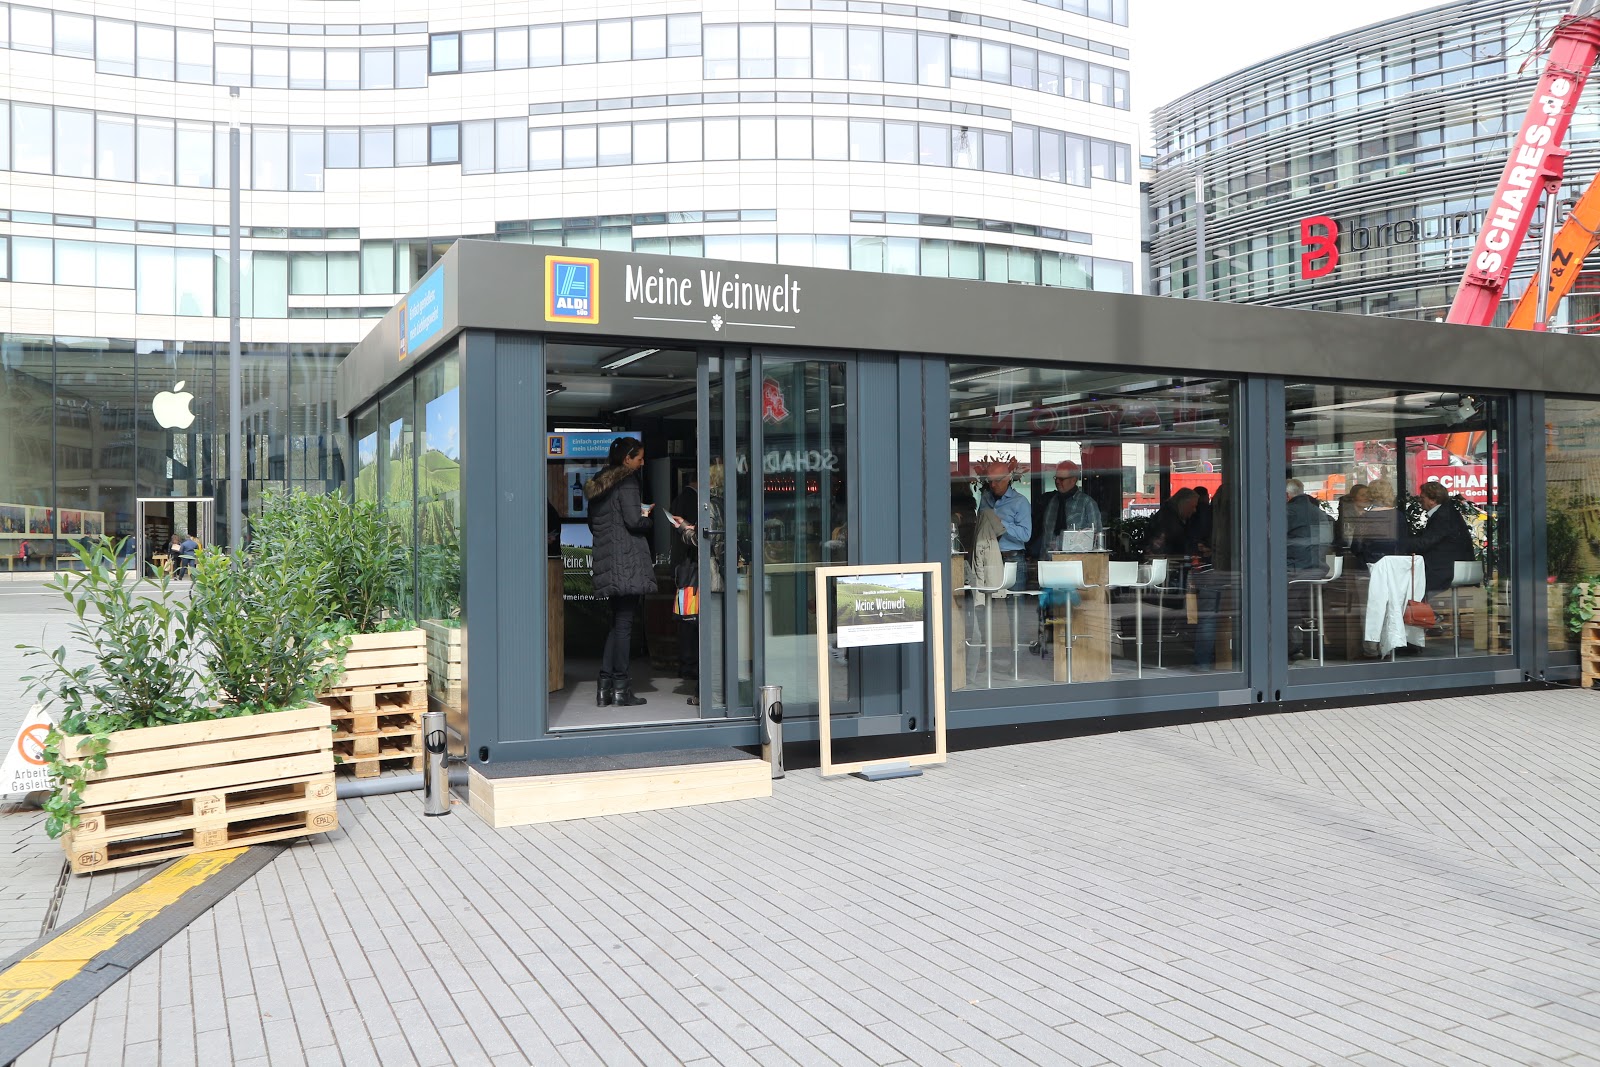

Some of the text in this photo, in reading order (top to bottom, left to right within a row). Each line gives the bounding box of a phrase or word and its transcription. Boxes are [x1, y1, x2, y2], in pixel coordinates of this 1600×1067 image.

[1476, 77, 1571, 274] SCHARES.de
[556, 297, 588, 310] ALDI
[625, 264, 801, 313] Meine Weinwelt
[856, 596, 906, 611] Meine Weinwelt
